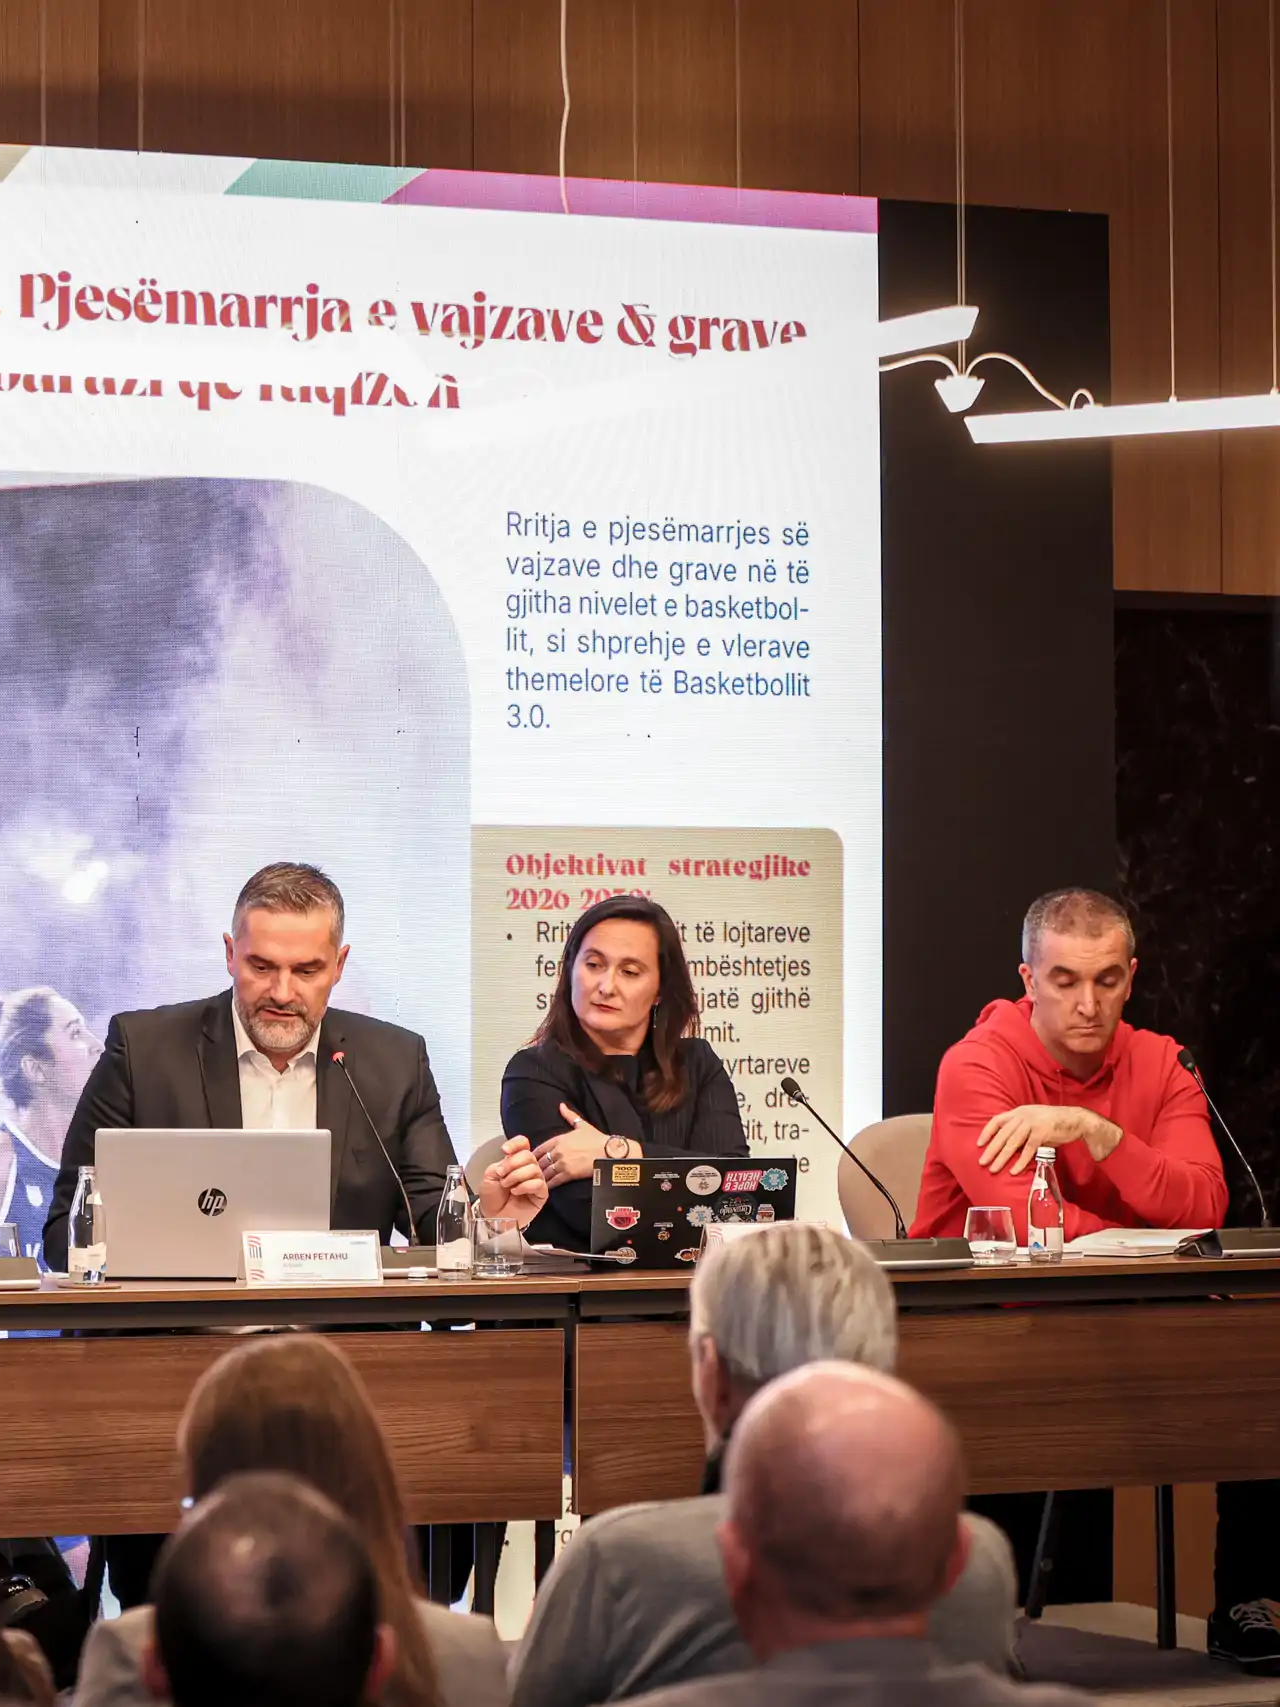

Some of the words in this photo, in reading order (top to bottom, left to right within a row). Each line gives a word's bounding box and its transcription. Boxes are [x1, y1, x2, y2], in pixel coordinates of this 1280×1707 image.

[20, 271, 353, 341] Pjesëmarrja
[368, 298, 398, 332] e
[411, 290, 604, 350] vajzave
[617, 302, 657, 346] &
[668, 314, 808, 360] grave
[506, 511, 570, 544] Rritja
[583, 520, 597, 538] e
[609, 516, 770, 549] pjesëmarrjes
[782, 521, 809, 547] së
[506, 551, 601, 581] vajzave
[612, 554, 658, 580] dhe
[669, 561, 737, 586] grave
[748, 559, 777, 583] në
[787, 560, 809, 585] të
[506, 589, 571, 619] gjitha
[580, 590, 657, 616] nivelet
[664, 598, 677, 617] e
[685, 594, 809, 620] basketbol-
[506, 627, 534, 656] lit,
[547, 628, 565, 653] si
[577, 630, 685, 661] shprehje
[696, 637, 711, 656] e
[722, 634, 809, 658] vlerave
[506, 666, 629, 692] themelore
[640, 669, 662, 693] të
[674, 670, 810, 696] Basketbollit
[506, 704, 550, 728] 3.0.
[506, 853, 646, 879] Objektivat
[669, 855, 811, 881] strategjike
[695, 921, 715, 943] të
[723, 921, 810, 948] lojtareve
[695, 987, 739, 1014] jatë
[751, 986, 811, 1014] gjithë
[774, 1121, 810, 1140] tra-
[726, 1172, 761, 1182] HEALTH
[733, 1180, 757, 1191] HOPE
[200, 1189, 227, 1217] hp
[282, 1252, 312, 1261] ARBEN
